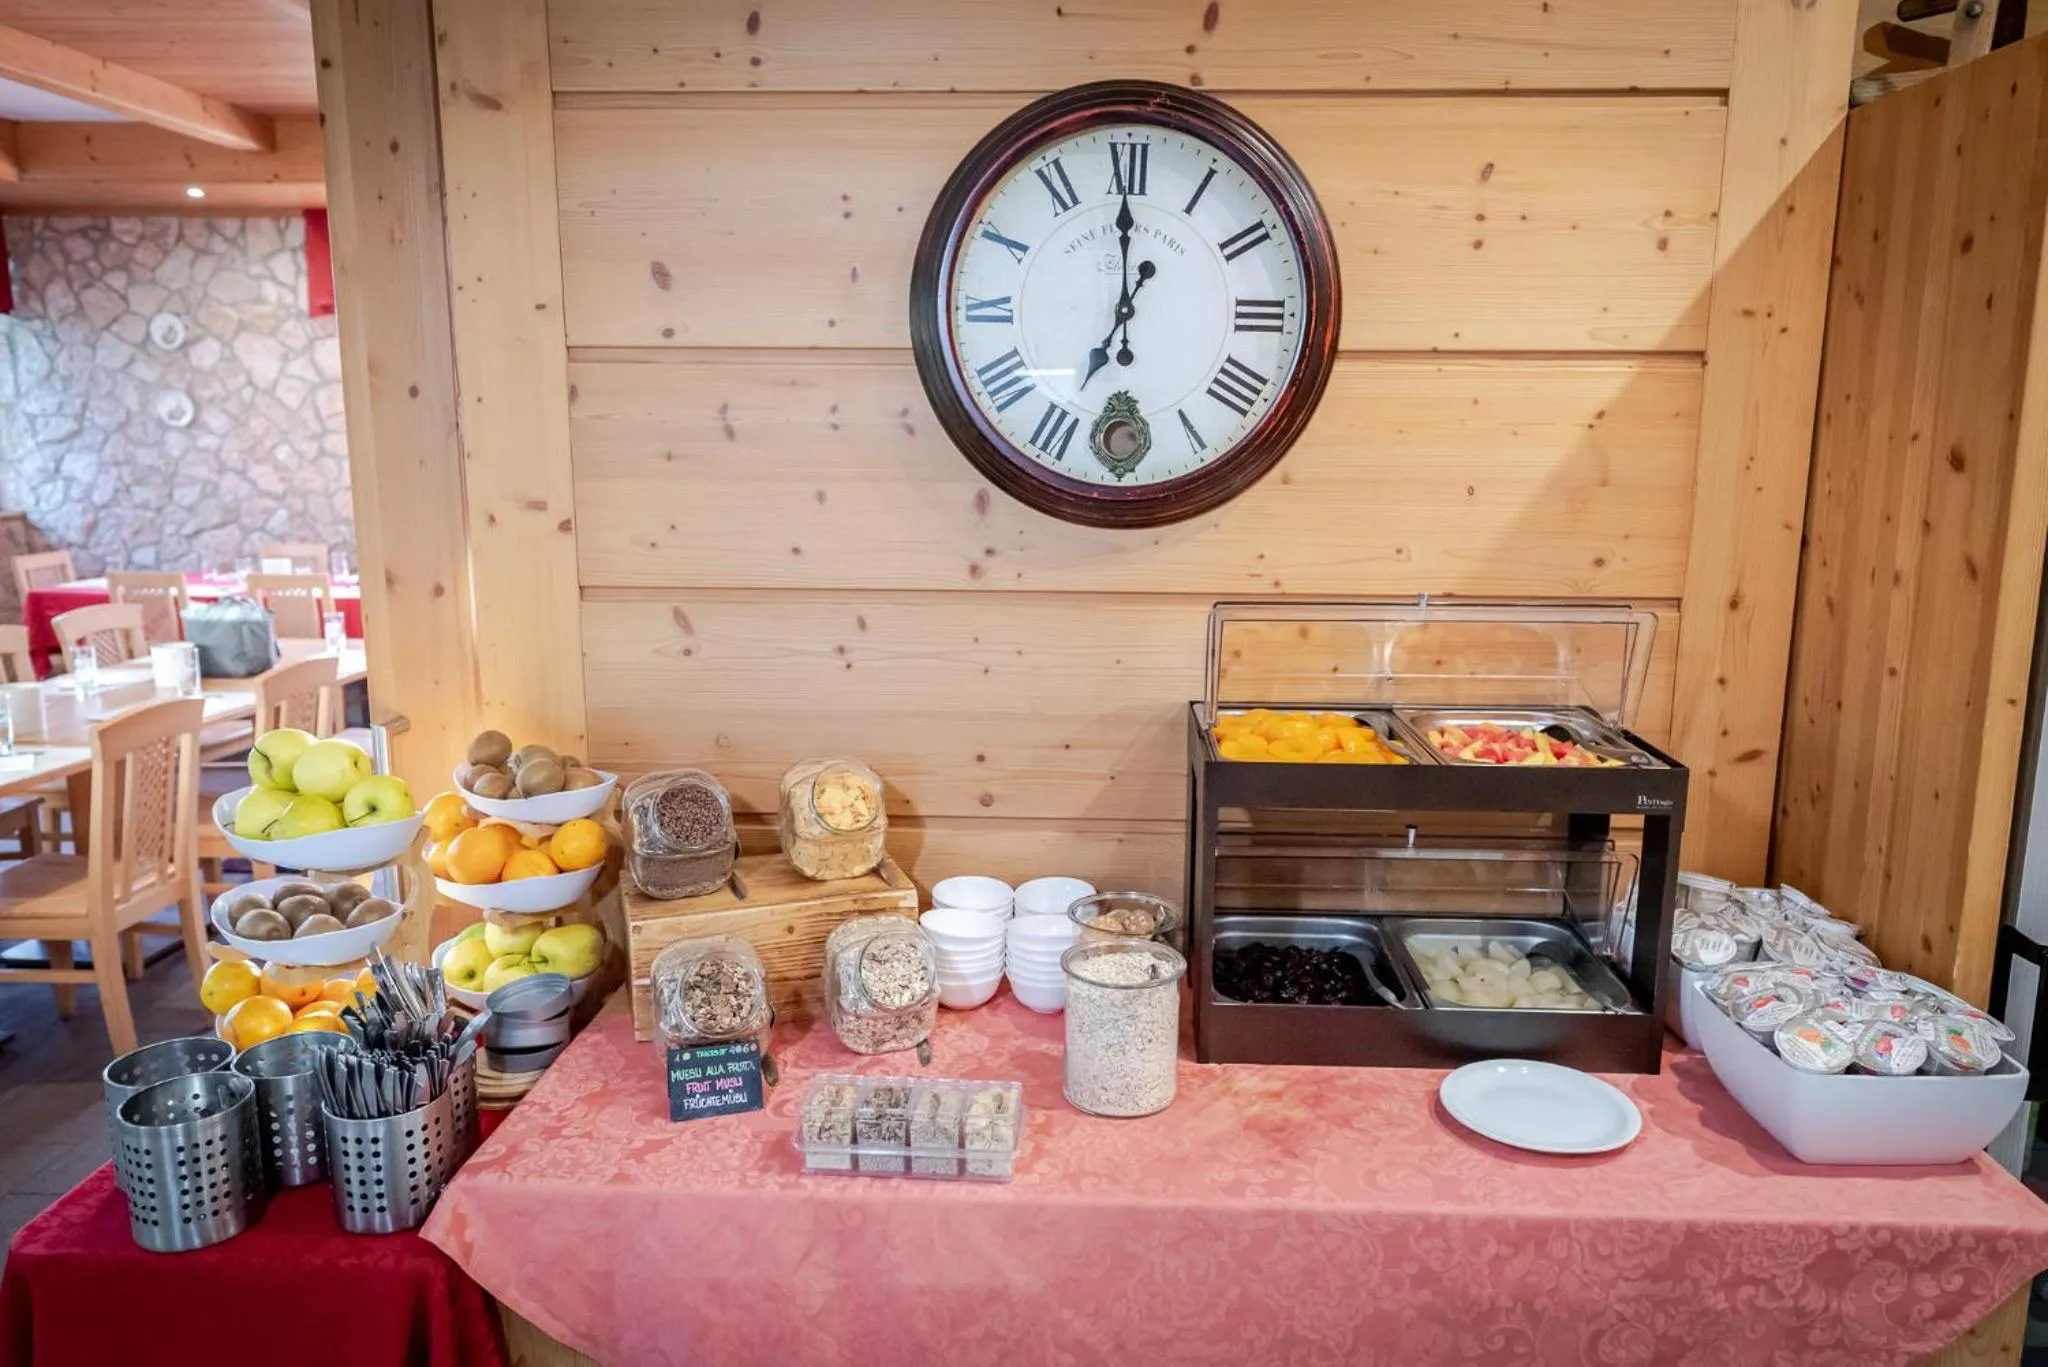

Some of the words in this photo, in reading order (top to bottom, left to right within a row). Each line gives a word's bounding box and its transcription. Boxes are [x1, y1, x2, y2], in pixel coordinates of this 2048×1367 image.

[1034, 156, 1082, 218] XI
[1105, 142, 1151, 196] XII
[1183, 166, 1219, 216] I
[980, 220, 1031, 264] X
[1153, 228, 1188, 256] PARIS
[1218, 219, 1272, 265] II
[966, 295, 1014, 325] IX
[1234, 298, 1285, 334] III
[976, 347, 1037, 413] VIII
[1205, 354, 1269, 417] IIII
[1028, 402, 1081, 462] VII
[1177, 408, 1208, 454] V
[670, 1067, 703, 1082] MUESLI
[705, 1064, 726, 1077] ALLA
[685, 1080, 713, 1095] FRUIT
